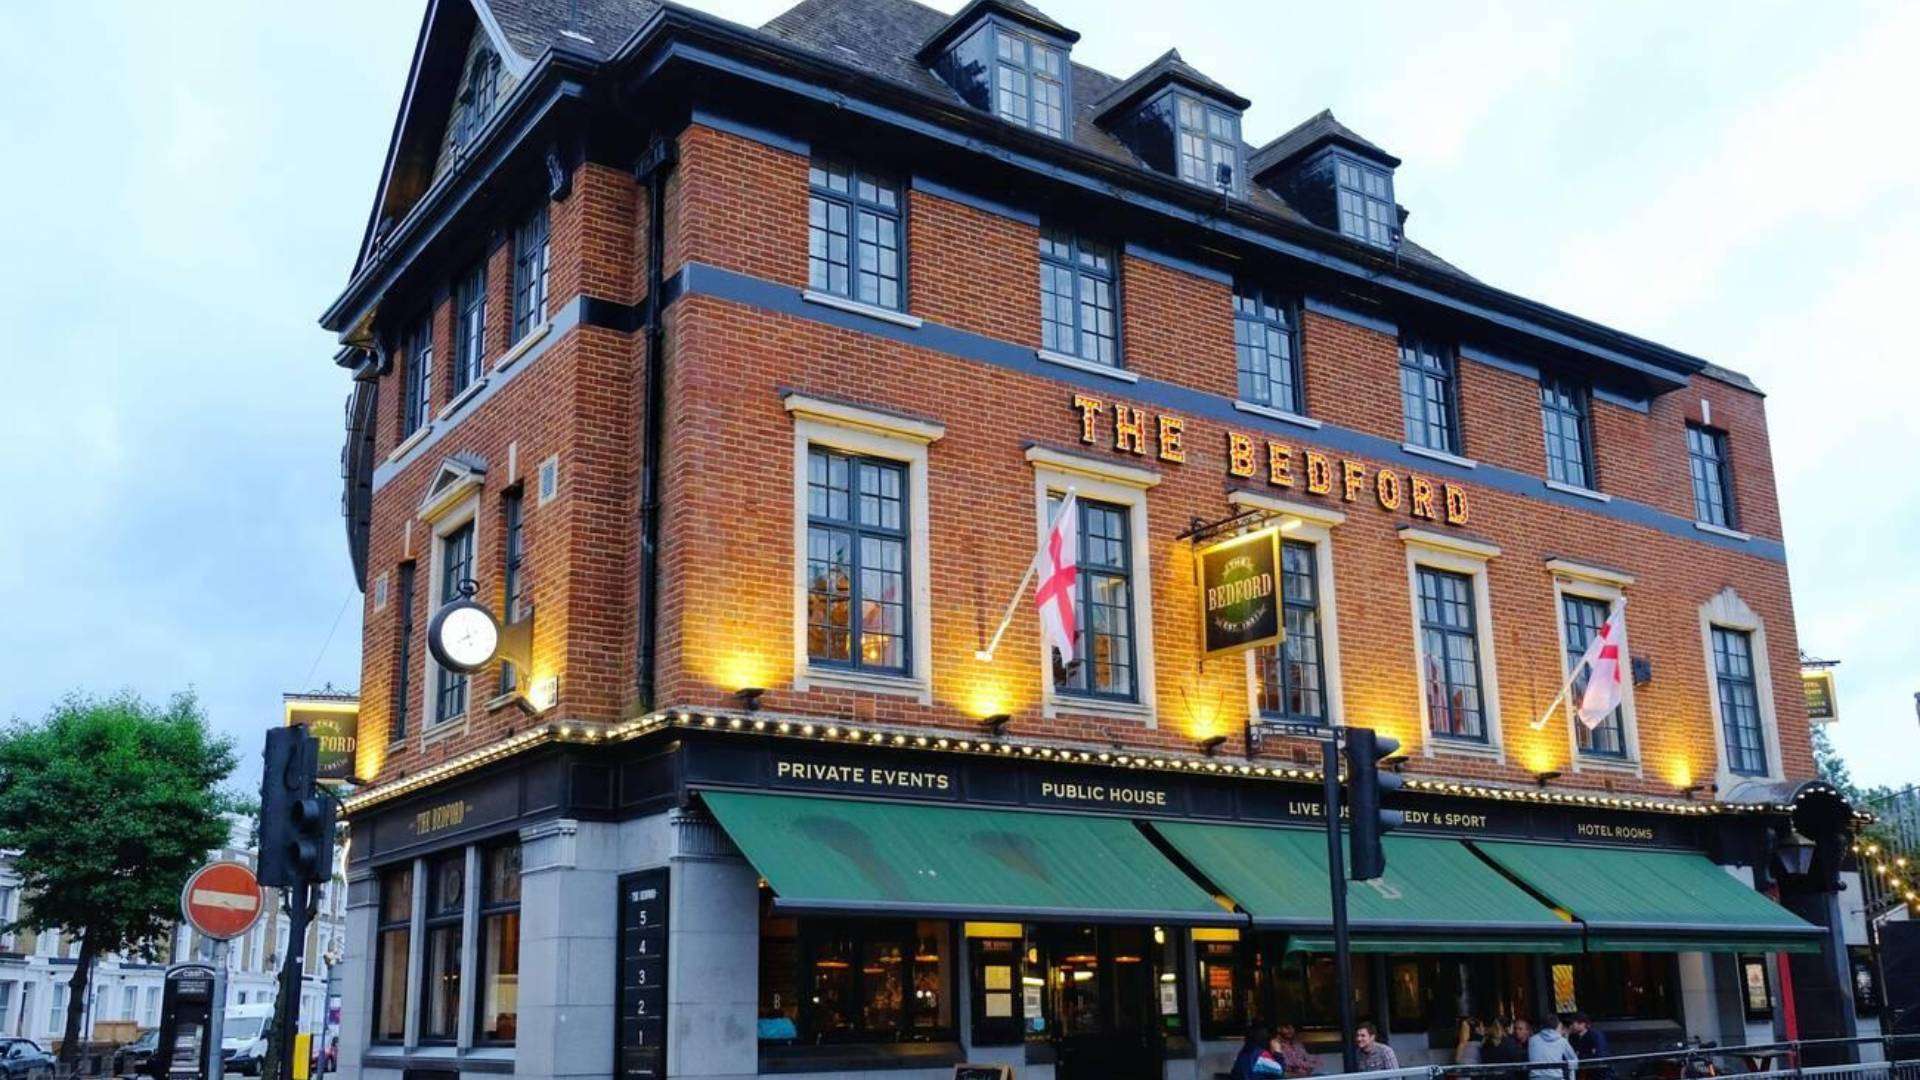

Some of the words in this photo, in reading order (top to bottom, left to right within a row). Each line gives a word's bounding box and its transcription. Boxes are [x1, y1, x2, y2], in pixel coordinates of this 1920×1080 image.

[1075, 394, 1185, 463] THE
[1229, 431, 1468, 525] BEDFORD
[1208, 573, 1272, 611] BEDFORD
[319, 736, 356, 752] FORD
[777, 761, 865, 783] PRIVATE
[871, 769, 949, 789] EVENTS
[1042, 782, 1105, 800] PUBLIC
[1110, 788, 1167, 805] HOUSE
[1289, 801, 1320, 816] LIVE
[1401, 810, 1429, 824] EDY
[1433, 813, 1442, 824] &
[1445, 813, 1487, 828] SPORT
[1577, 823, 1613, 837] HOTEL
[1615, 826, 1654, 839] ROOMS
[639, 910, 647, 925] 5
[638, 940, 646, 954] 4
[638, 969, 646, 984] 3
[637, 1000, 645, 1015] 2
